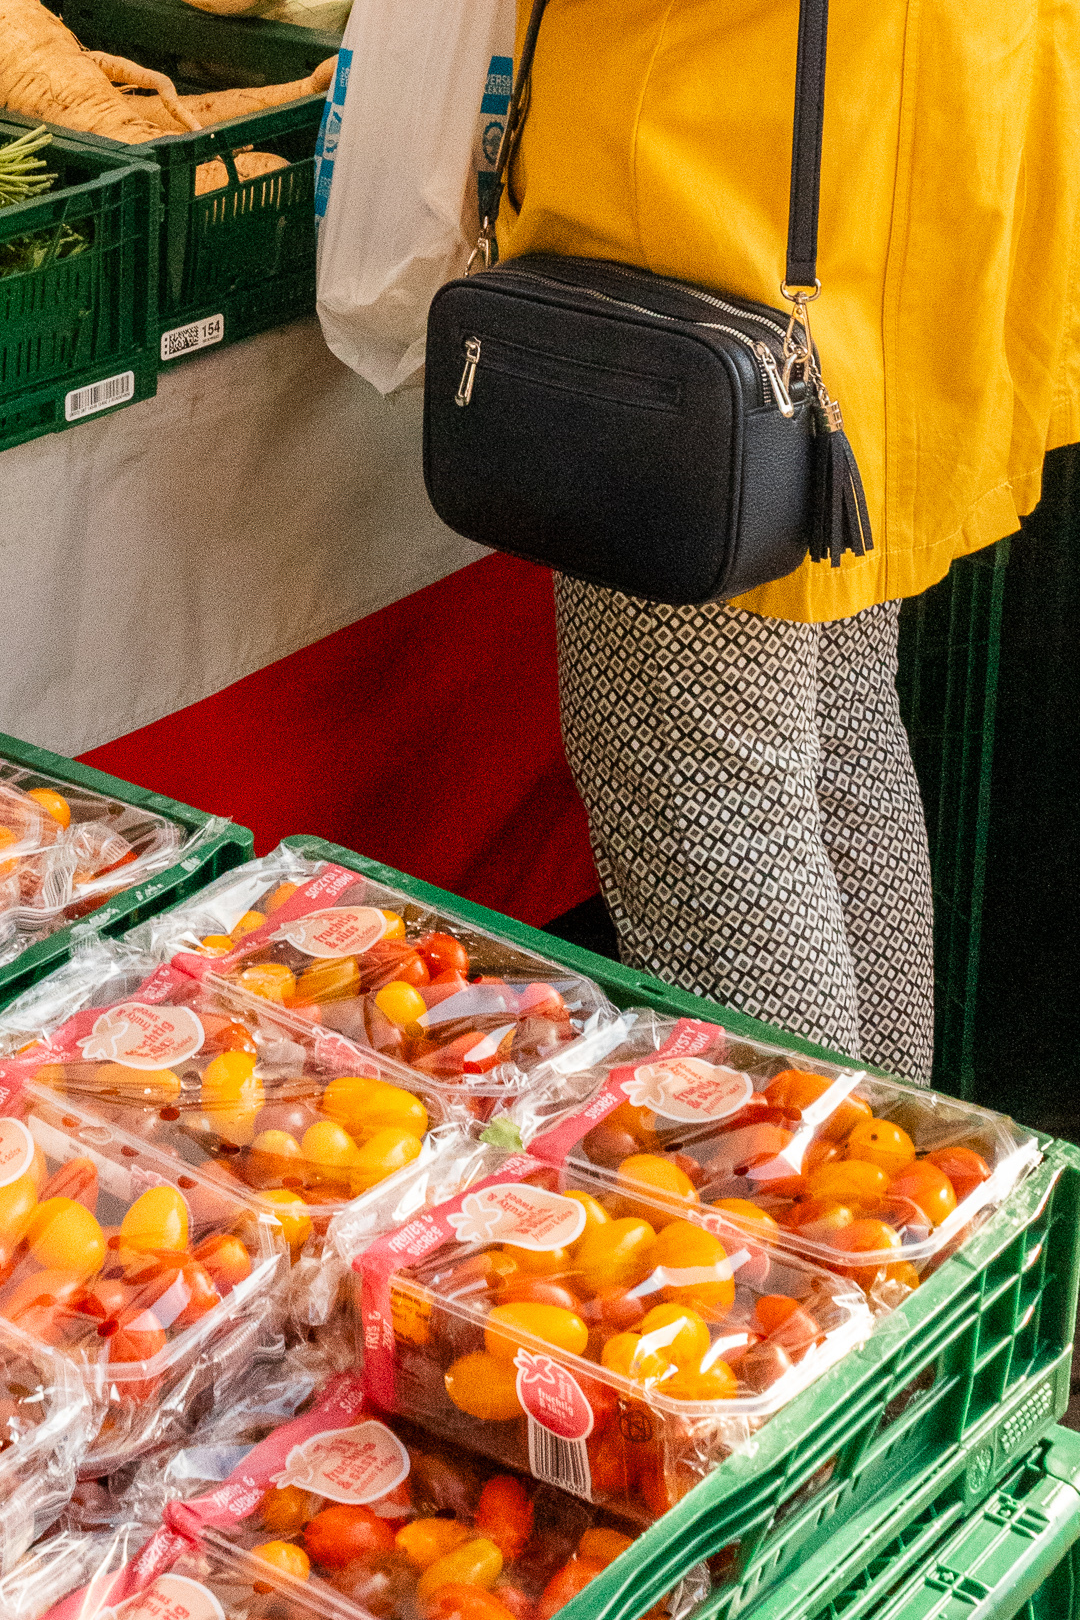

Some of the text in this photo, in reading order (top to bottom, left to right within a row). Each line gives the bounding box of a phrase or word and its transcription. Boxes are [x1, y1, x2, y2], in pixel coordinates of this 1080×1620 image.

[201, 319, 221, 338] 154
[311, 913, 360, 945] fruchtig
[332, 924, 360, 943] süss
